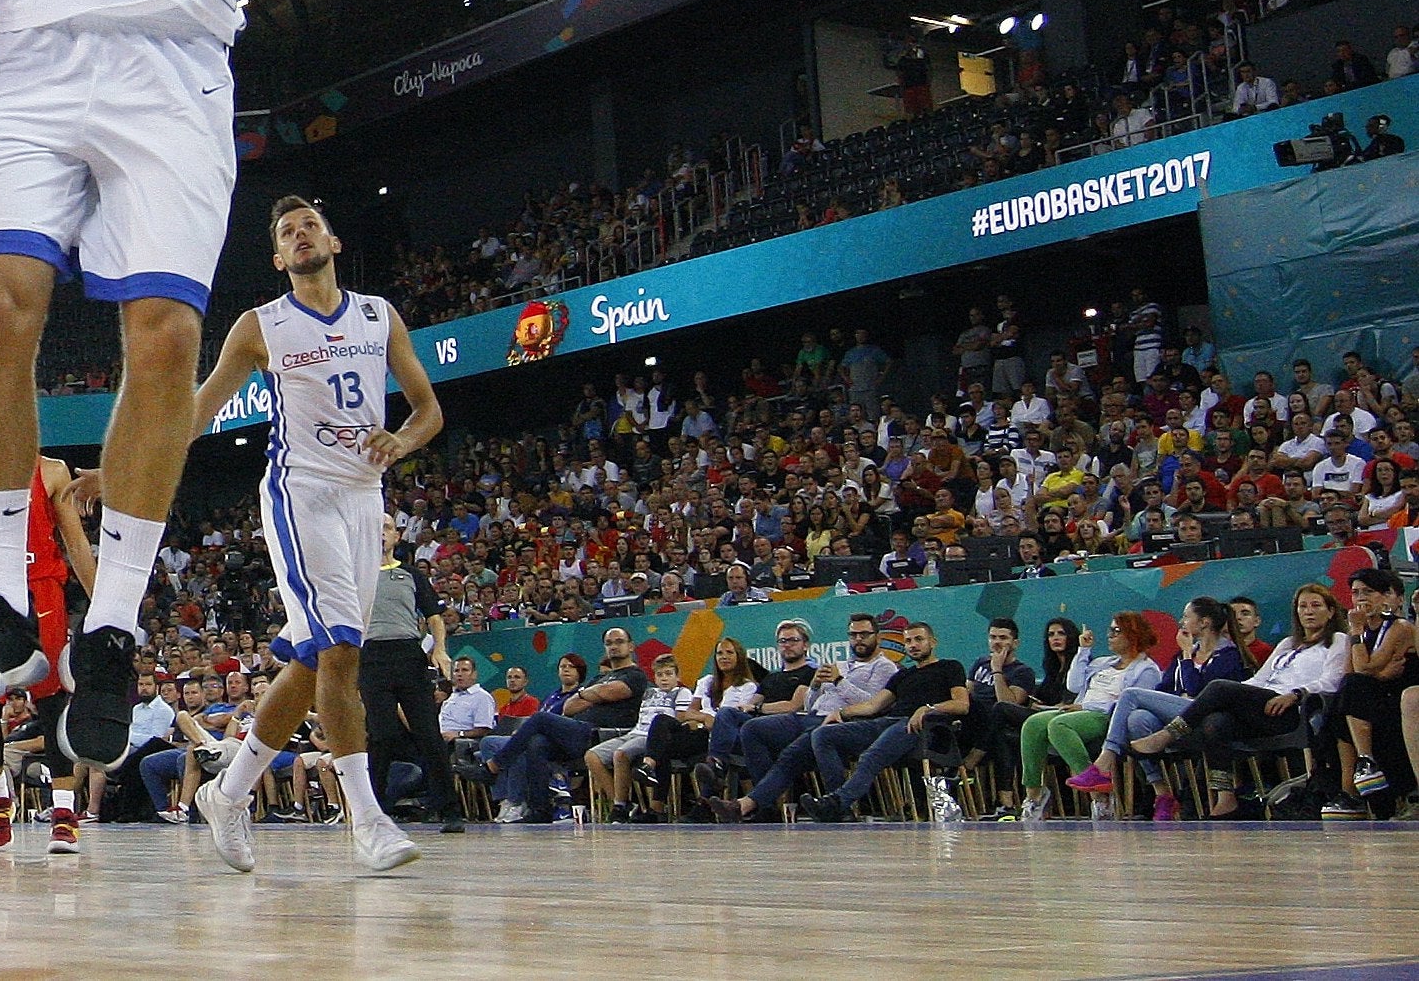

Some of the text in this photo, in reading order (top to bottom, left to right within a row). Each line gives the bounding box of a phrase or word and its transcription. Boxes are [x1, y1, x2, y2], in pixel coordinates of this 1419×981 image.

[393, 51, 484, 97] Cluj-Napoca
[971, 150, 1211, 237] #EUROBASKET2017
[590, 287, 670, 343] Spain
[435, 337, 459, 365] VS
[326, 371, 365, 410] 13
